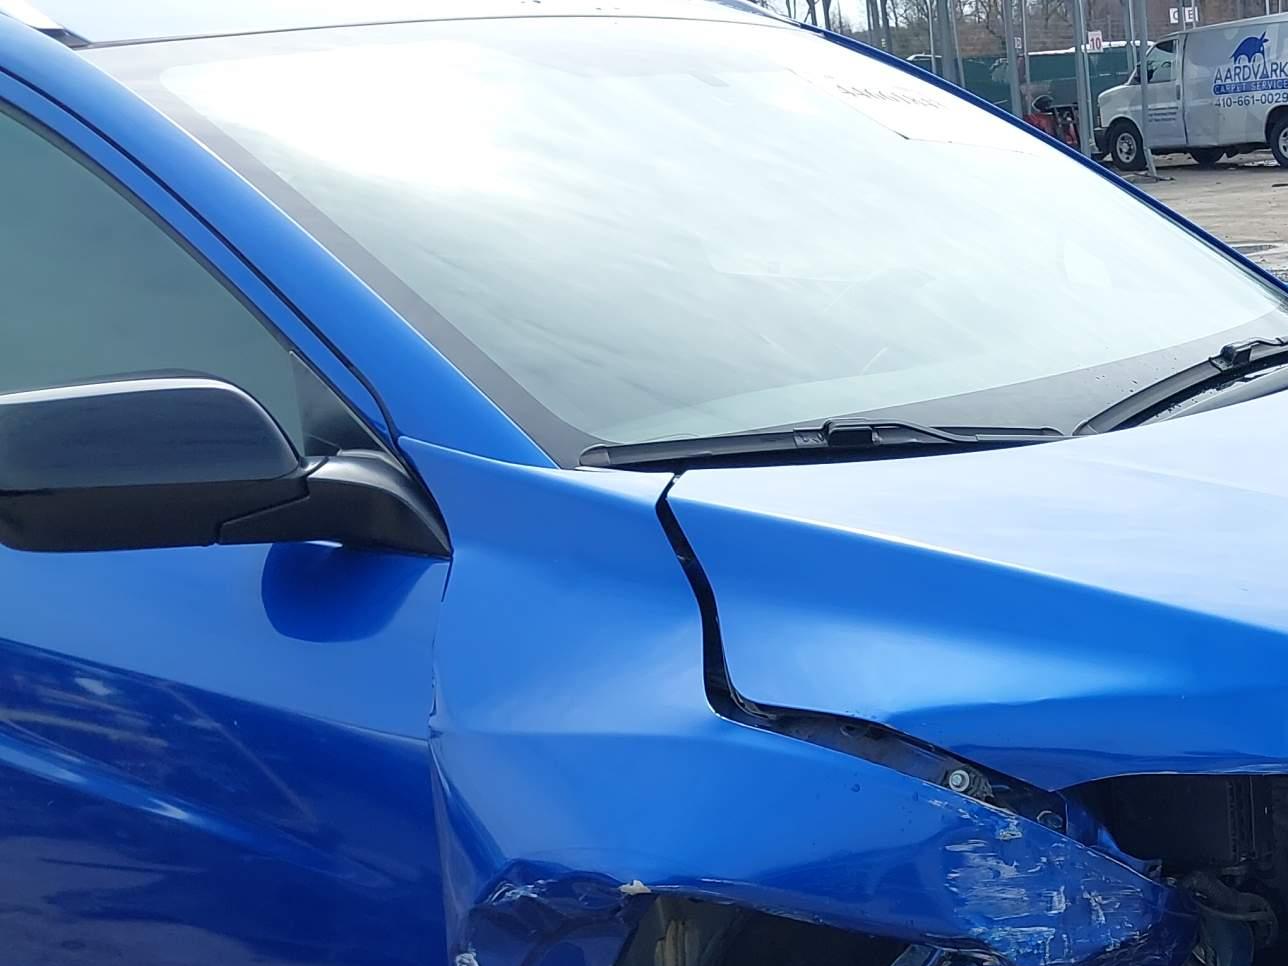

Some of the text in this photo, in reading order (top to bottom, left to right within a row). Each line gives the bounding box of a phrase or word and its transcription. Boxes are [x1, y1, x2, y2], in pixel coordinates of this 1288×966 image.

[1090, 37, 1101, 49] 10
[1214, 61, 1288, 84] AARDVARK
[1215, 78, 1288, 95] CARPET SERVICE
[1214, 92, 1288, 108] 410-661-0029
